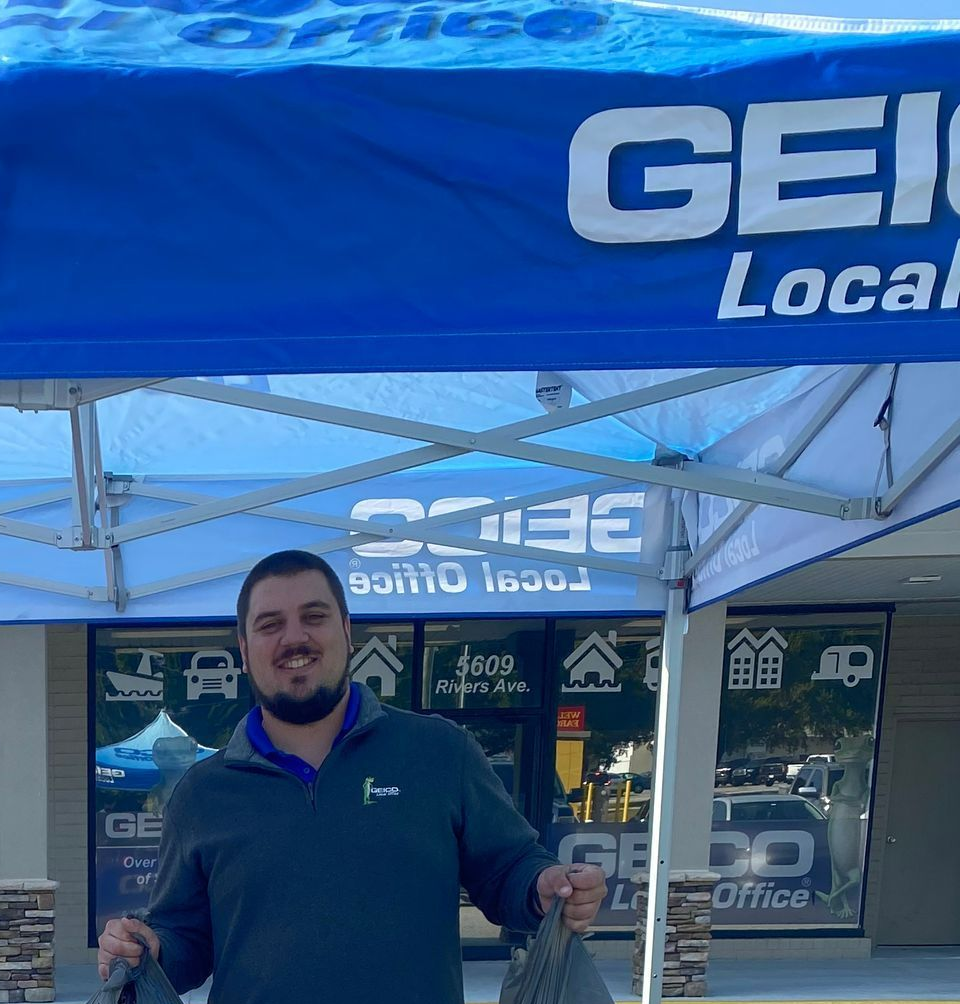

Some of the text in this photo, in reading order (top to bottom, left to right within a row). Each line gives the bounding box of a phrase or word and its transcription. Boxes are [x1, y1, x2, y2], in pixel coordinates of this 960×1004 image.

[567, 90, 960, 244] GEI
[455, 654, 515, 677] 5609
[435, 678, 531, 694] Rivers Ave.
[123, 856, 157, 869] Over
[558, 829, 815, 880] GECO
[711, 882, 811, 909] Office
